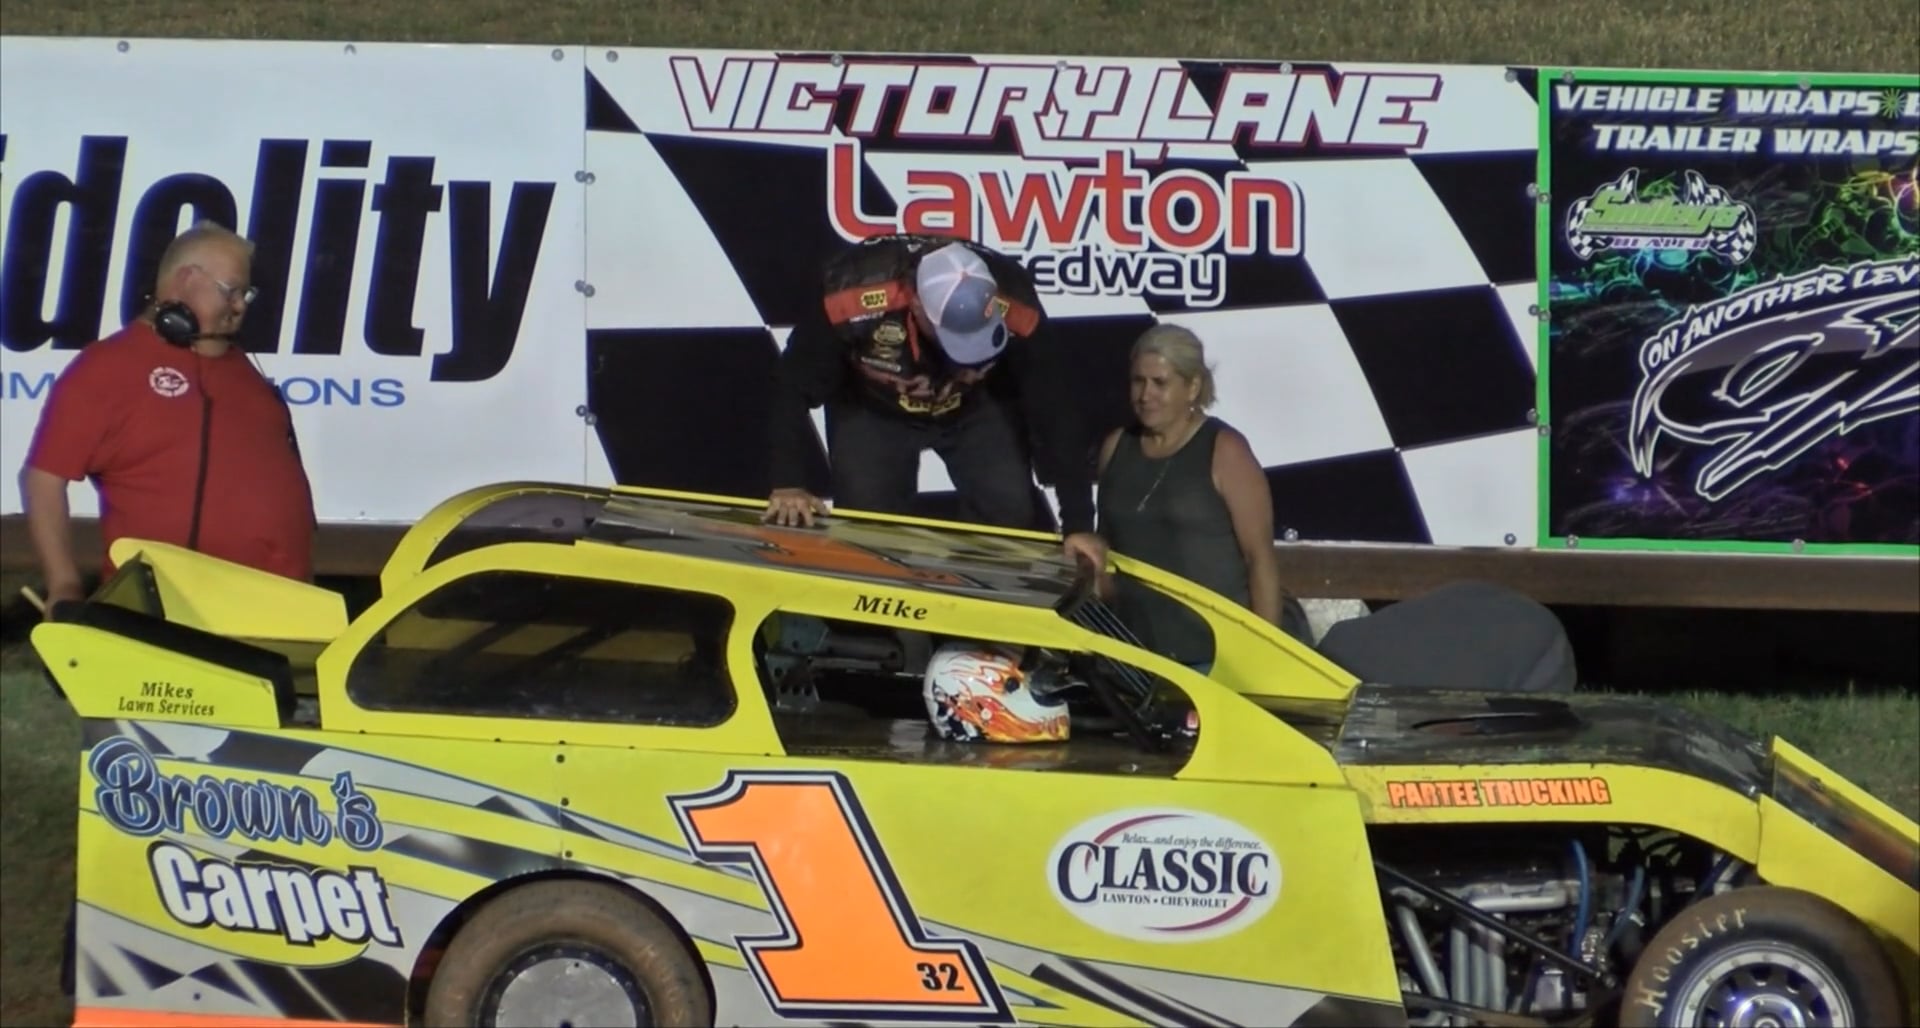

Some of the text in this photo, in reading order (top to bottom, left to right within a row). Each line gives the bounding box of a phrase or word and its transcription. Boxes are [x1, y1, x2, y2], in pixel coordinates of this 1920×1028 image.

[668, 56, 1443, 163] VICTORY LANE
[1555, 84, 1724, 114] VEHICLE
[1735, 88, 1882, 116] WRAPS
[1592, 124, 1919, 155] TRAILER WRAPS
[828, 142, 1299, 249] Lawton
[1003, 246, 1224, 302] edway
[1647, 328, 1678, 368] ON
[1682, 272, 1848, 351] ANOTHER
[852, 594, 928, 620] Mike
[118, 696, 215, 716] Lawn Services
[140, 681, 194, 699] Mikes
[89, 736, 383, 853] Brown's
[1386, 777, 1613, 809] PARTEE TRUCKING
[1174, 837, 1199, 849] enjoy
[1199, 836, 1214, 847] the
[147, 841, 404, 947] Carpet
[1057, 842, 1269, 904] CLASSIC
[665, 769, 1018, 1022] 1
[1102, 892, 1229, 909] LAWTON CHEVROLET
[915, 962, 965, 992] 32
[1634, 907, 1747, 1018] Hoosier
